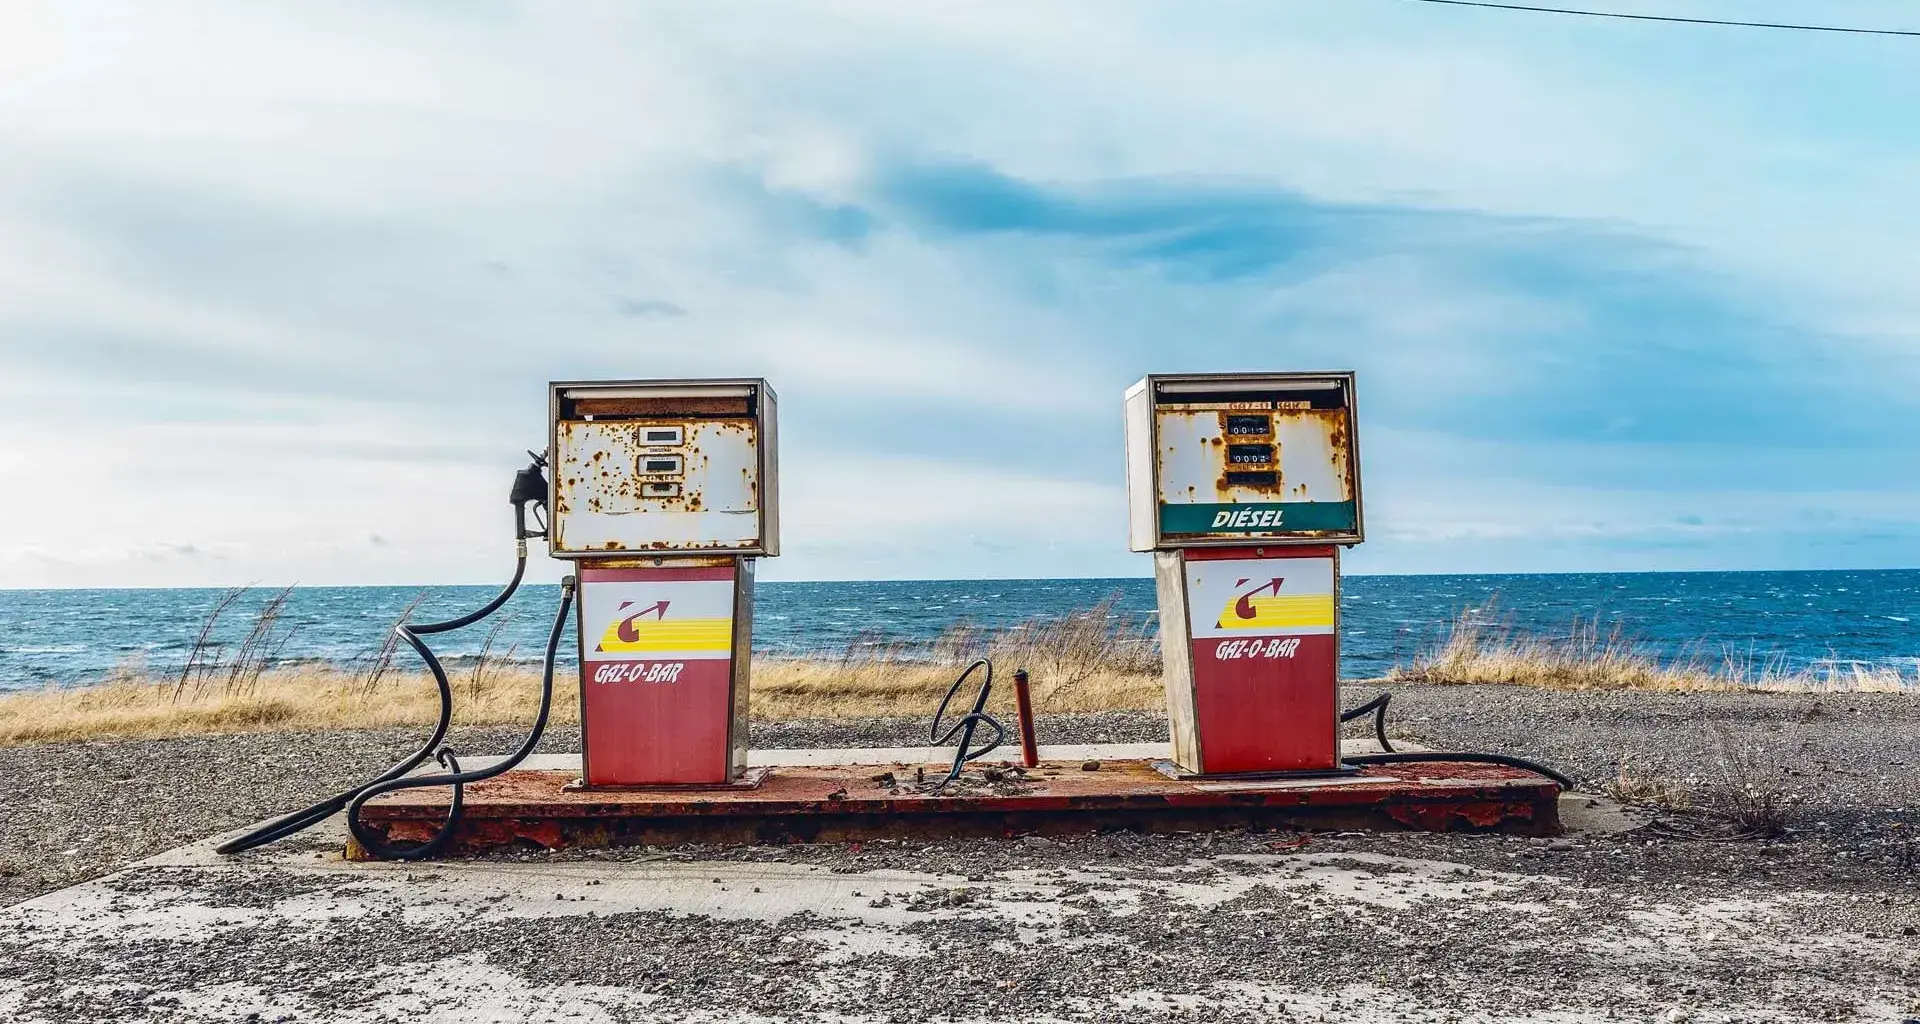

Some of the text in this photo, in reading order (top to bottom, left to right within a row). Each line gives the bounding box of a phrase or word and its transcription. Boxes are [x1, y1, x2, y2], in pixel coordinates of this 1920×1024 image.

[1211, 506, 1283, 528] DIÉSEL
[1215, 639, 1301, 660] GAZ-O-BAR
[594, 663, 684, 684] GAZ-O-BAR
